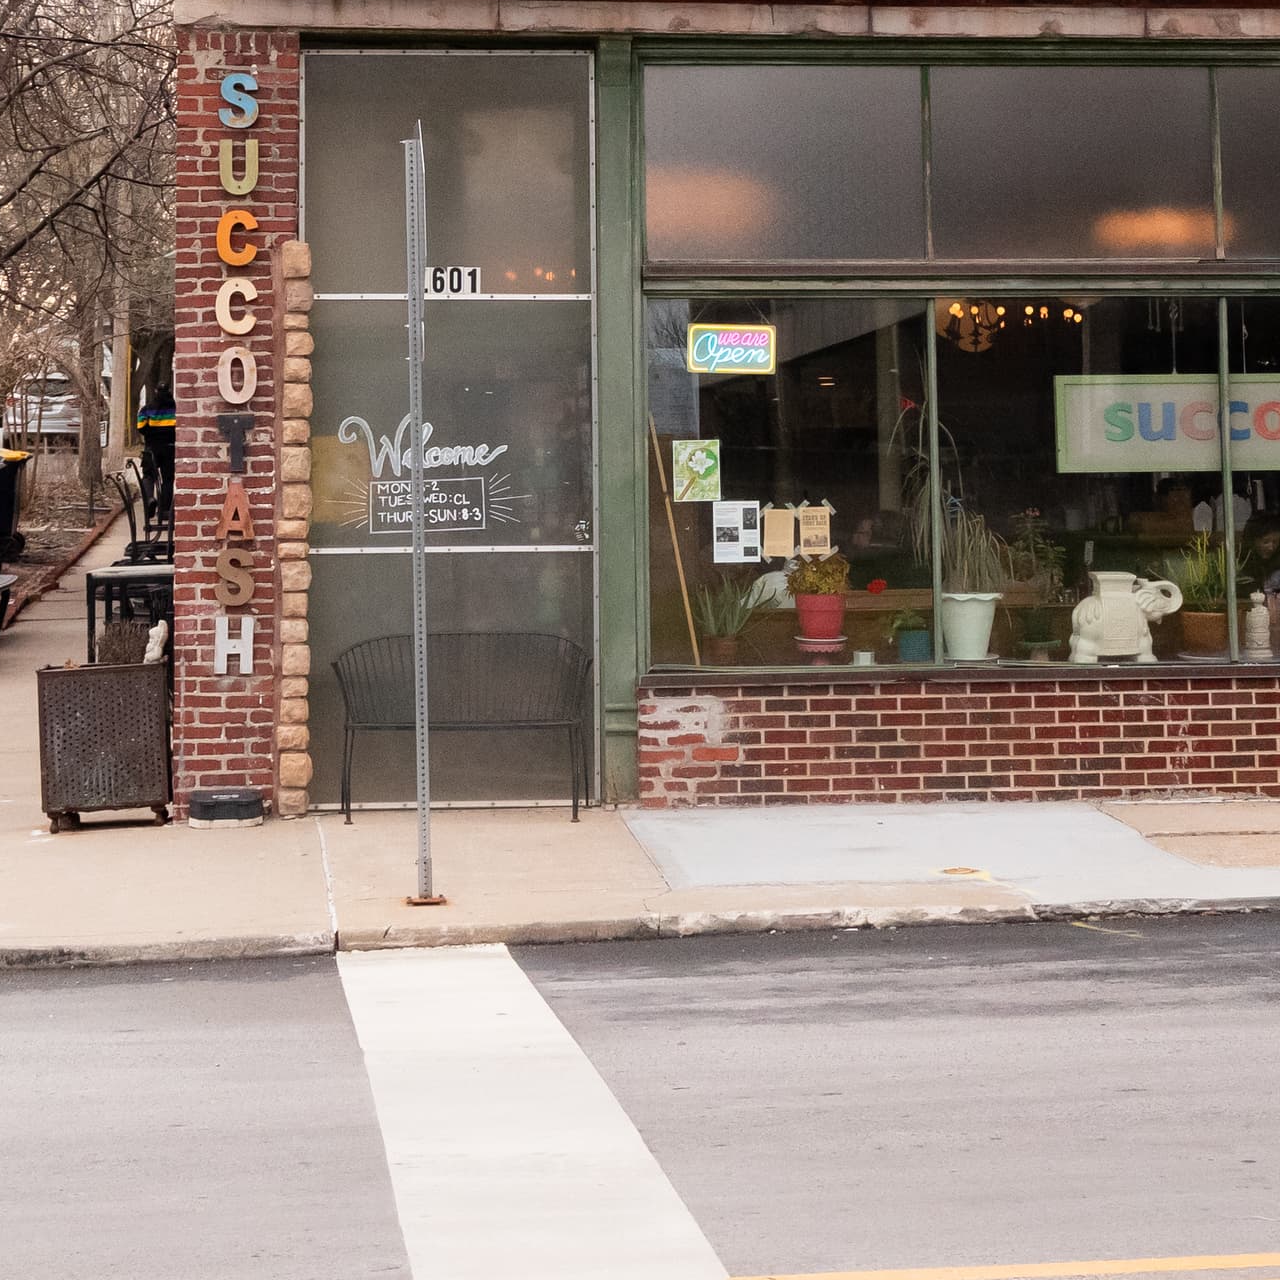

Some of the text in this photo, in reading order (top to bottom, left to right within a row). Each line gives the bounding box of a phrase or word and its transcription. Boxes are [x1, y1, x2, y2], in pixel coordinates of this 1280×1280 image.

[424, 267, 477, 294] 601
[693, 332, 770, 372] Open
[741, 332, 769, 347] are
[214, 73, 259, 675] SUCCOTASH
